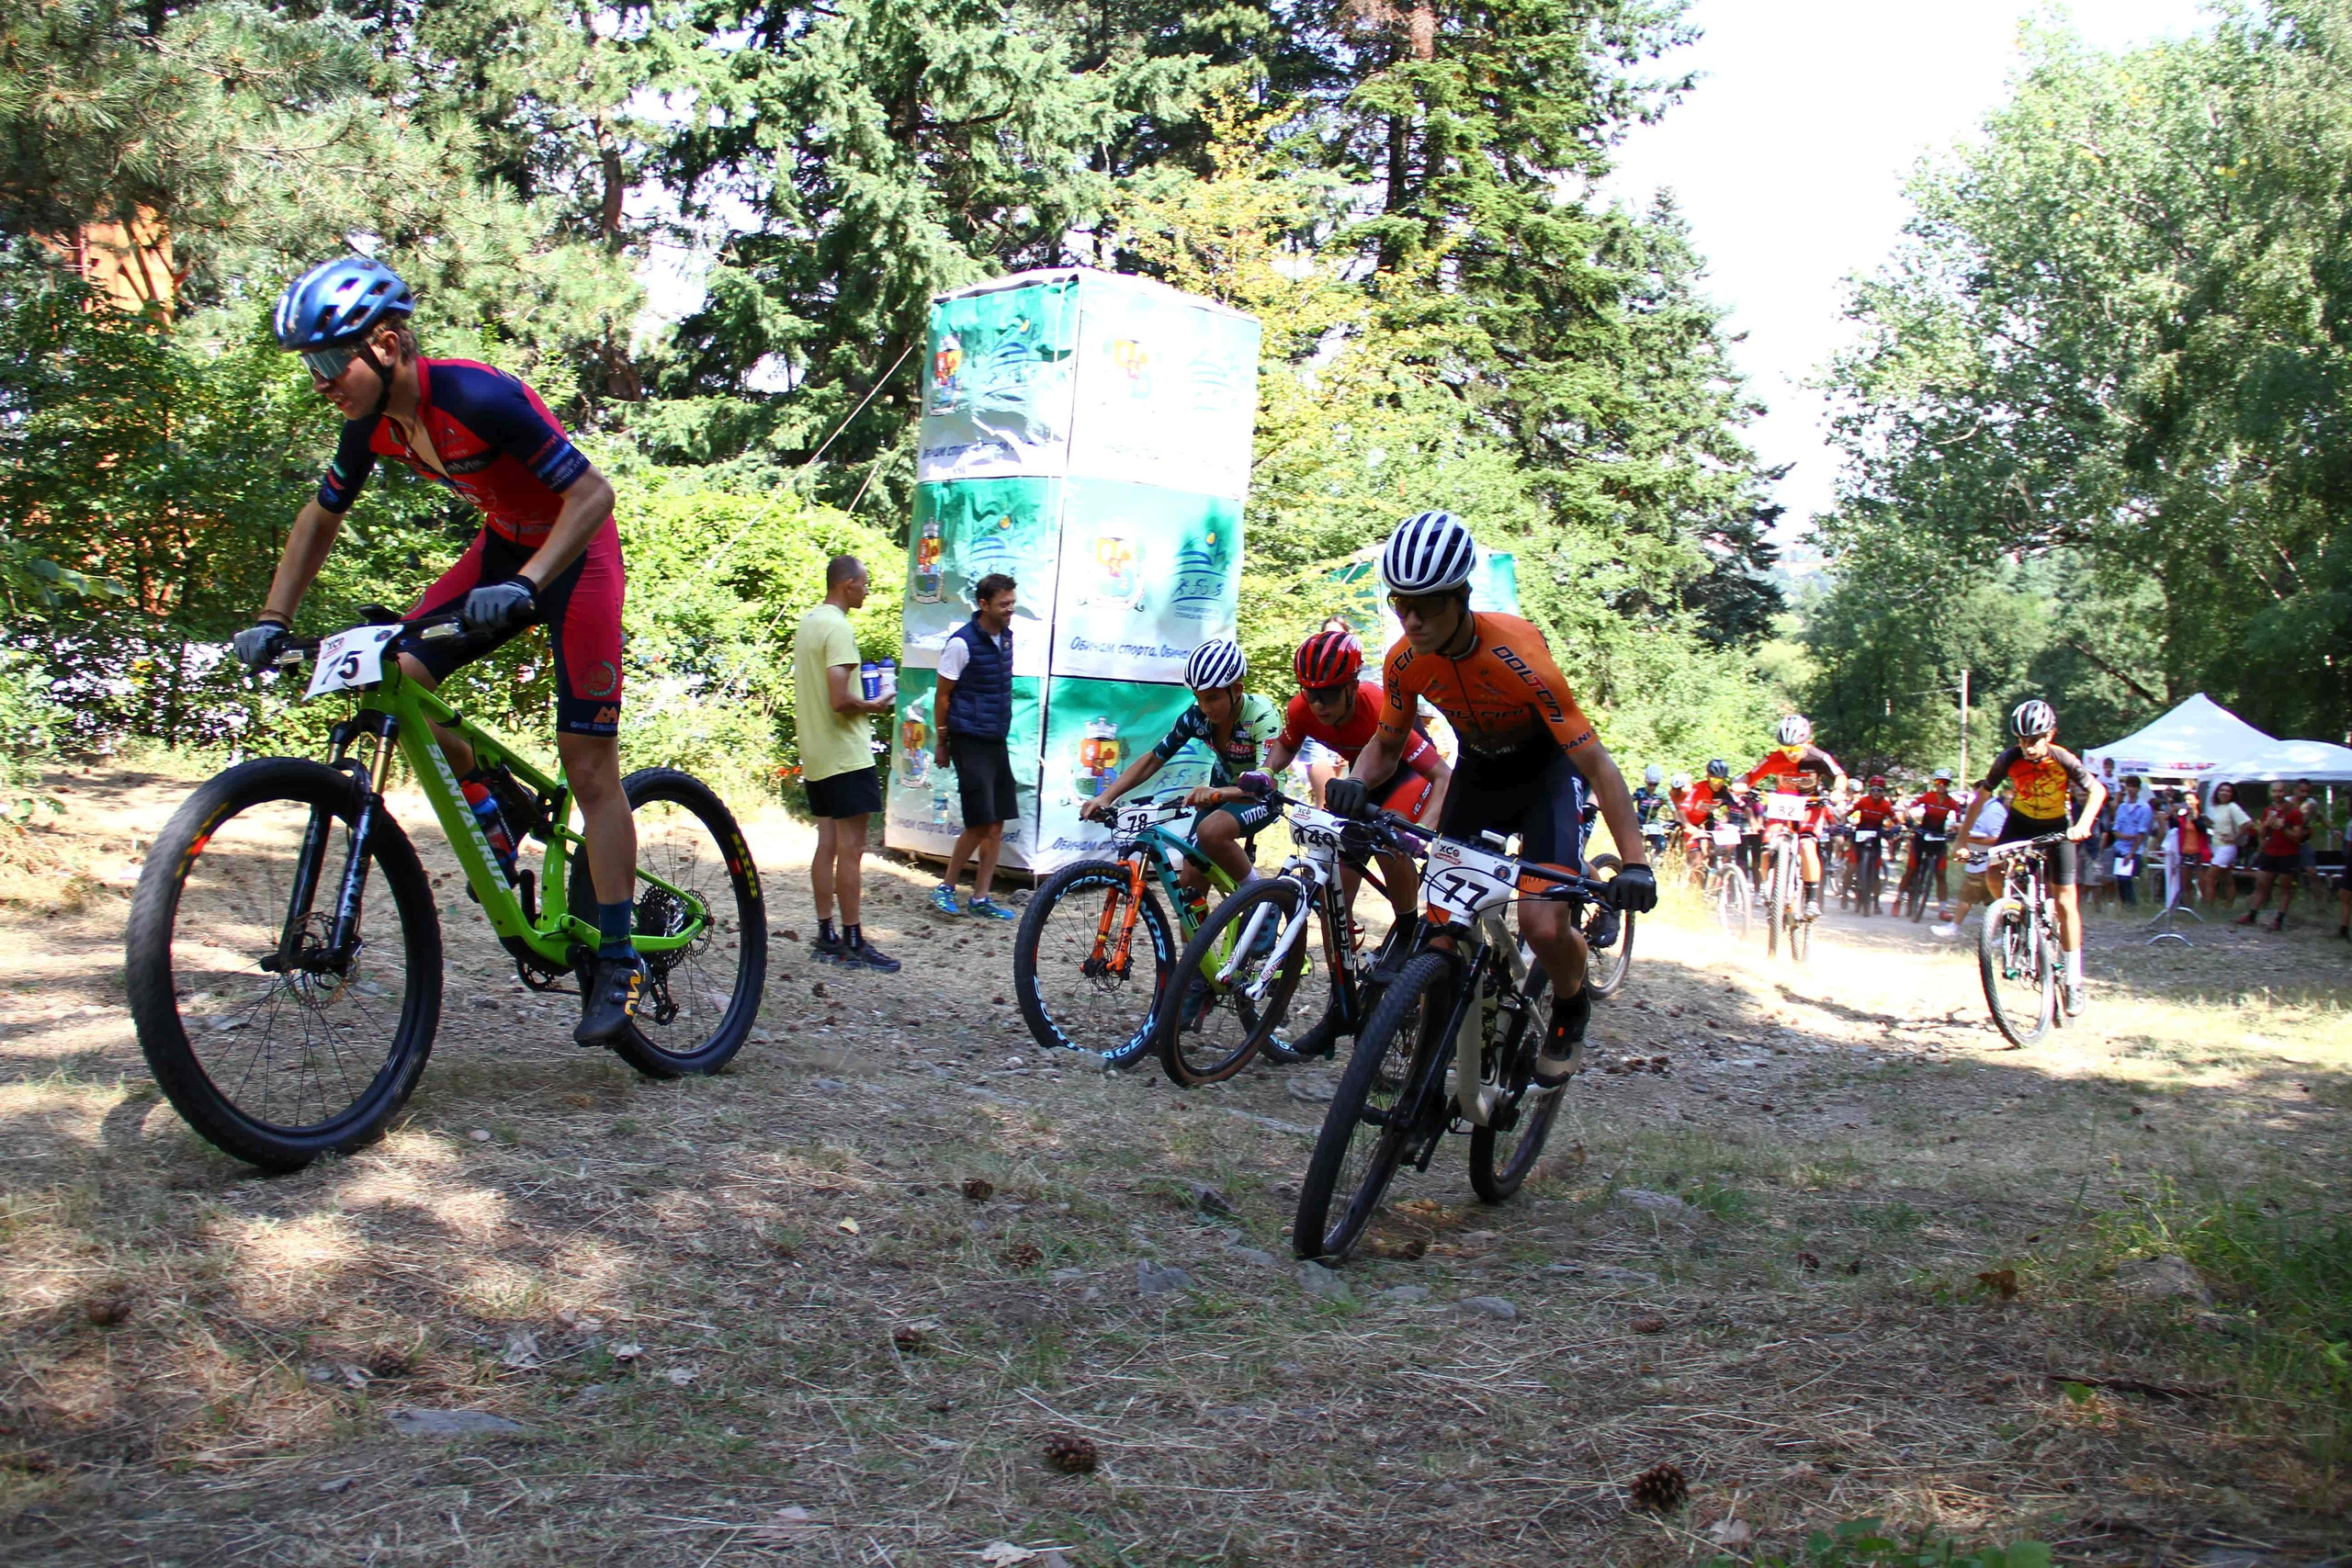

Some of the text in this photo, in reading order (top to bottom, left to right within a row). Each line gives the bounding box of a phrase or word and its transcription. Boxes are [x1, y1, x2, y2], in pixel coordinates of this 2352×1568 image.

[321, 650, 365, 685] 75
[1160, 644, 1192, 660] Обича
[1490, 644, 1566, 724] DOLTCINI
[426, 743, 476, 829] SANTA
[470, 829, 512, 895] CRUZ
[1127, 813, 1148, 833] 78
[1443, 873, 1489, 912] 77
